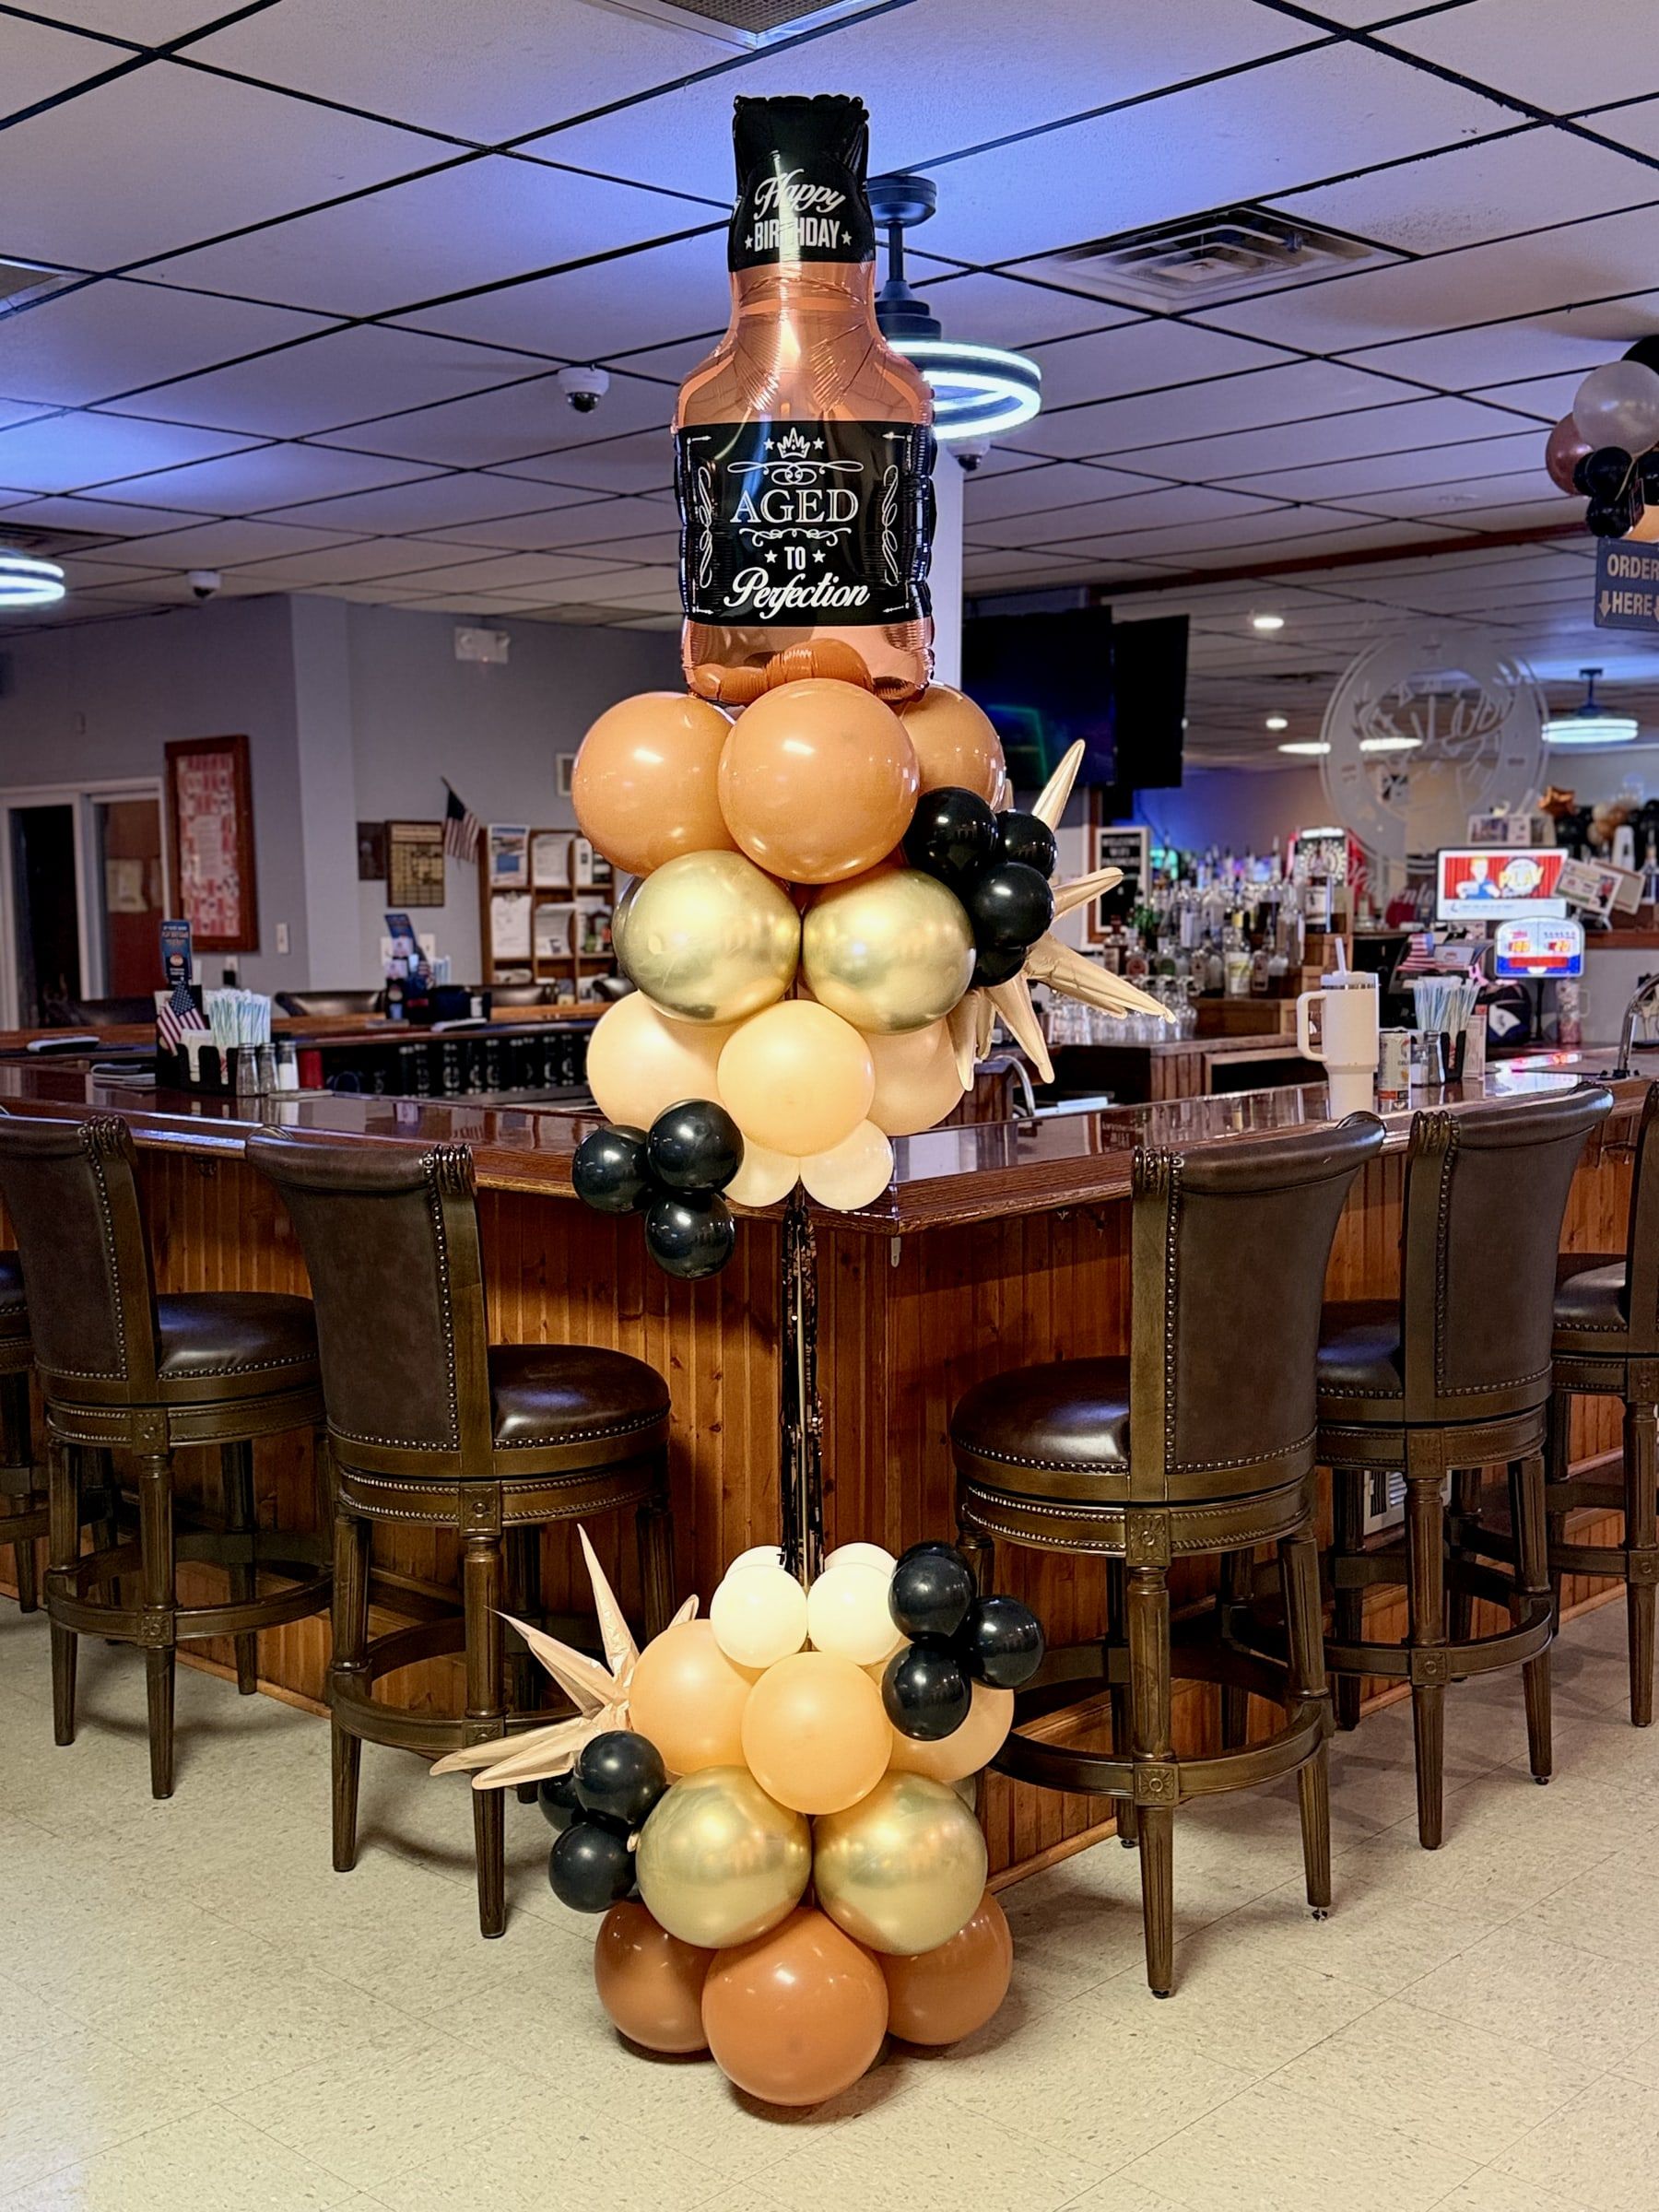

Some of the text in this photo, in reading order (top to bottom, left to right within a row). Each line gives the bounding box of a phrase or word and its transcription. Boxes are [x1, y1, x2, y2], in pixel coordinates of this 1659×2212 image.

[753, 169, 847, 221] Happy
[730, 488, 859, 524] AGED
[784, 547, 806, 571] TO
[1606, 553, 1659, 582] ORDER
[724, 567, 870, 620] Perfection
[1611, 591, 1653, 617] HERE
[1498, 865, 1545, 889] PLAY
